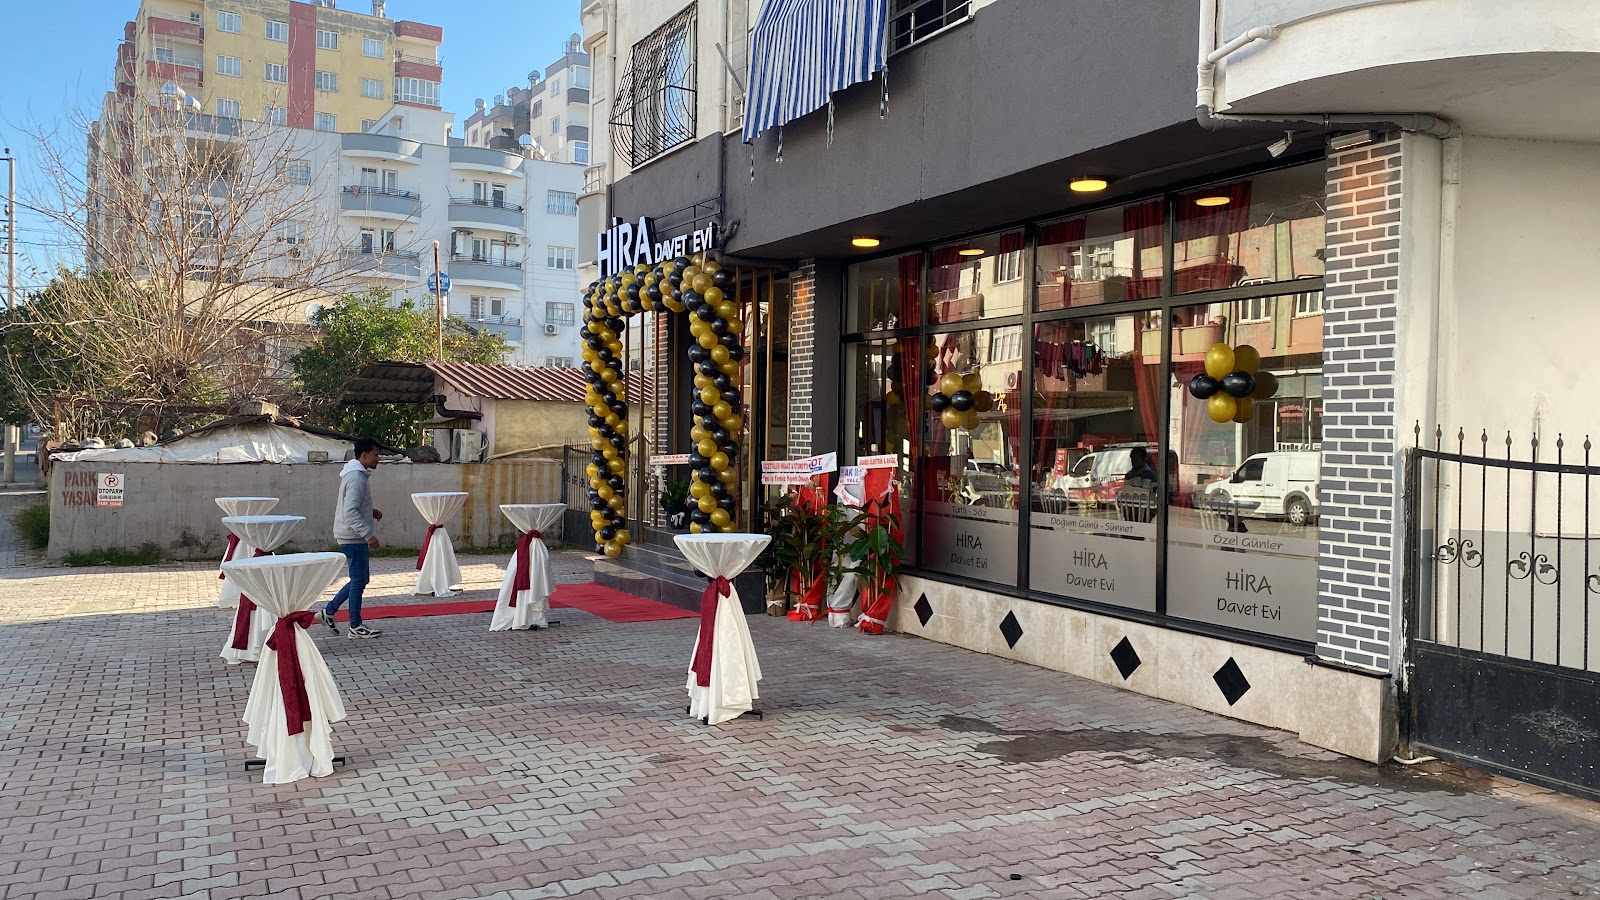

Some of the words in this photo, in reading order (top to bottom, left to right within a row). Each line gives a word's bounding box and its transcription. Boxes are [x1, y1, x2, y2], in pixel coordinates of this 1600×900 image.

[597, 215, 652, 278] HİRA
[654, 234, 688, 264] DAVET
[693, 222, 712, 252] EVİ
[64, 471, 97, 487] PARK
[951, 505, 967, 516] Tatlı
[973, 507, 987, 517] Söz
[1050, 516, 1077, 530] Doğum
[1078, 518, 1099, 530] Günü
[1105, 521, 1134, 533] Sünnet
[956, 530, 983, 551] HİRA
[1213, 532, 1239, 546] Özel
[1241, 536, 1284, 550] Günler
[951, 553, 975, 568] Davet
[976, 557, 988, 569] Evi
[1073, 547, 1108, 570] HİRA
[1066, 572, 1098, 589] Davet
[1100, 578, 1115, 592] Evi
[1225, 568, 1272, 595] HİRA
[1217, 597, 1259, 617] Davet
[1262, 604, 1281, 621] Evi
